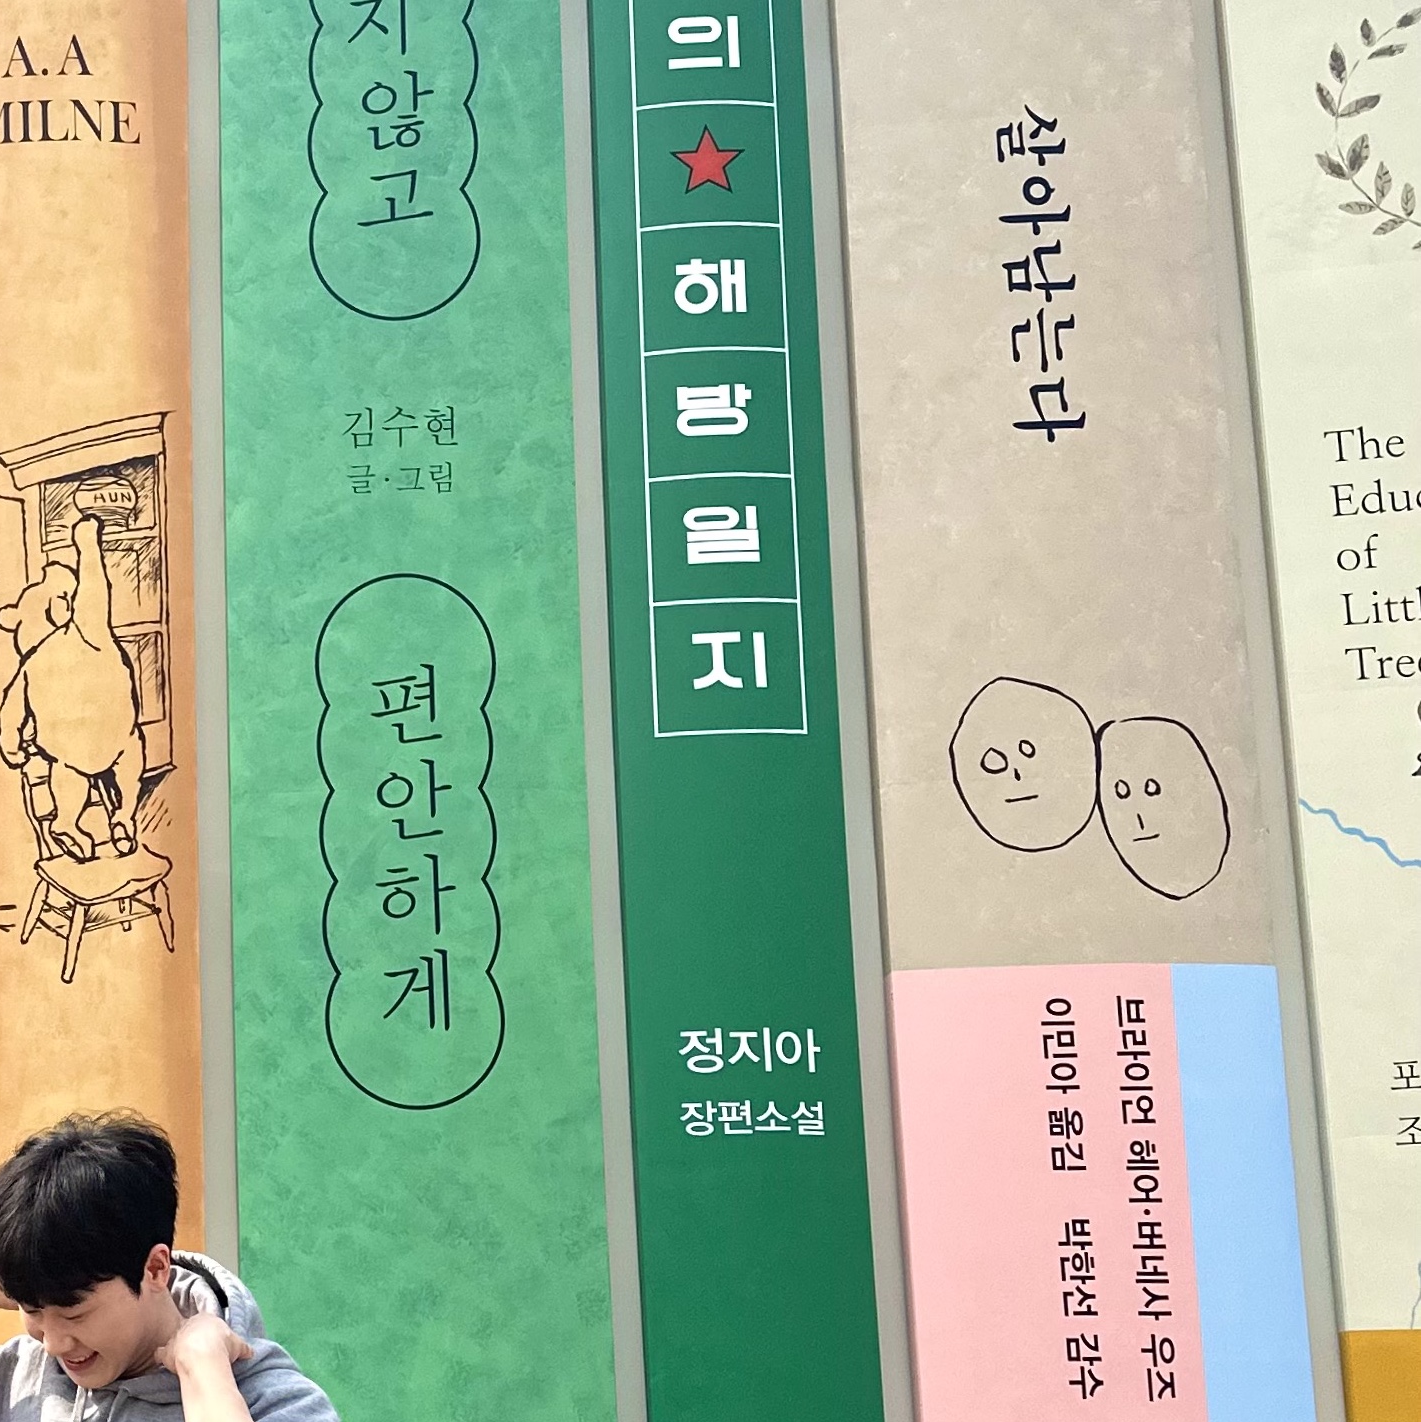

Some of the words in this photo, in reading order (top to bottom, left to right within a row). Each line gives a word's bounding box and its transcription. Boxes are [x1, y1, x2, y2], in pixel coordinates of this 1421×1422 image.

[3, 35, 93, 78] A.A
[668, 16, 741, 69] 의
[997, 105, 1086, 442] 살아남는다
[343, 406, 458, 448] 김수현
[1324, 426, 1404, 462] The
[93, 491, 132, 503] HUN
[673, 258, 769, 690] 해방일지
[1337, 534, 1378, 570] of
[1345, 647, 1421, 680] Tre
[371, 664, 456, 1031] 편안하게
[679, 1028, 820, 1073] 정지아
[1041, 999, 1080, 1094] 이민아
[680, 1100, 824, 1136] 장편소설
[1048, 1107, 1086, 1170] 옮김
[1116, 996, 1156, 1124] 브라이언
[1141, 1334, 1175, 1401] 우즈
[1058, 1219, 1098, 1316] 박한선
[1066, 1333, 1103, 1399] 감수
